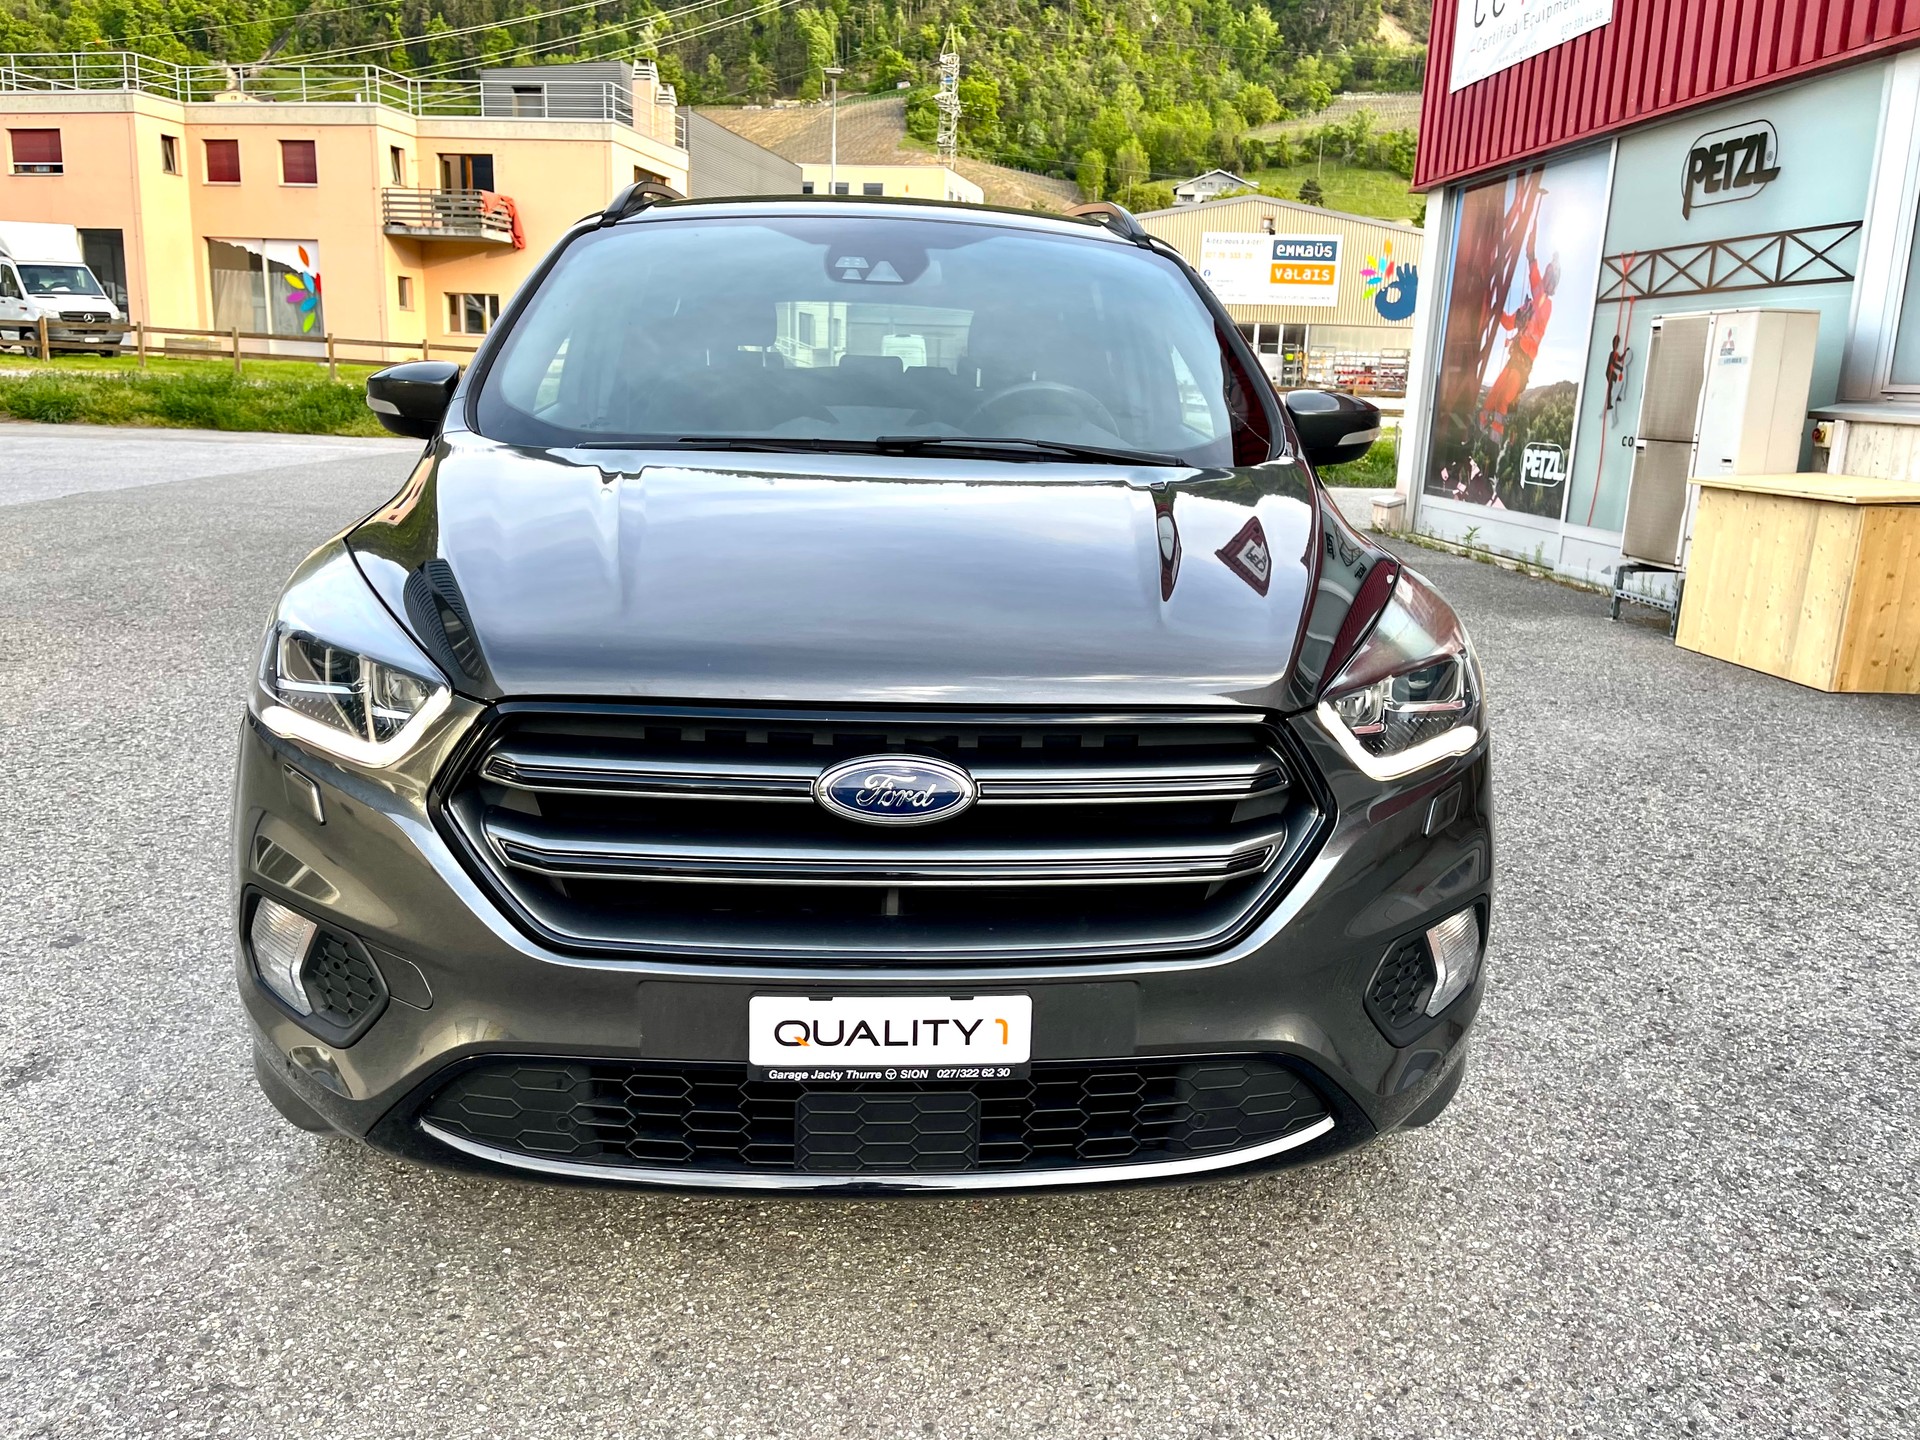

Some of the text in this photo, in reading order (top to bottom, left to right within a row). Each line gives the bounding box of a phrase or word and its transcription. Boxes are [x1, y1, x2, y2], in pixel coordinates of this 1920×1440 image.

[1524, 0, 1582, 31] Equipmen
[1683, 132, 1781, 221] PETZL
[1520, 449, 1566, 489] PETZL
[856, 773, 937, 808] Ford
[774, 1018, 1009, 1047] QUALITY 1
[768, 1067, 1010, 1081] Garage Jacky Thurre SION 027/322 62 30
